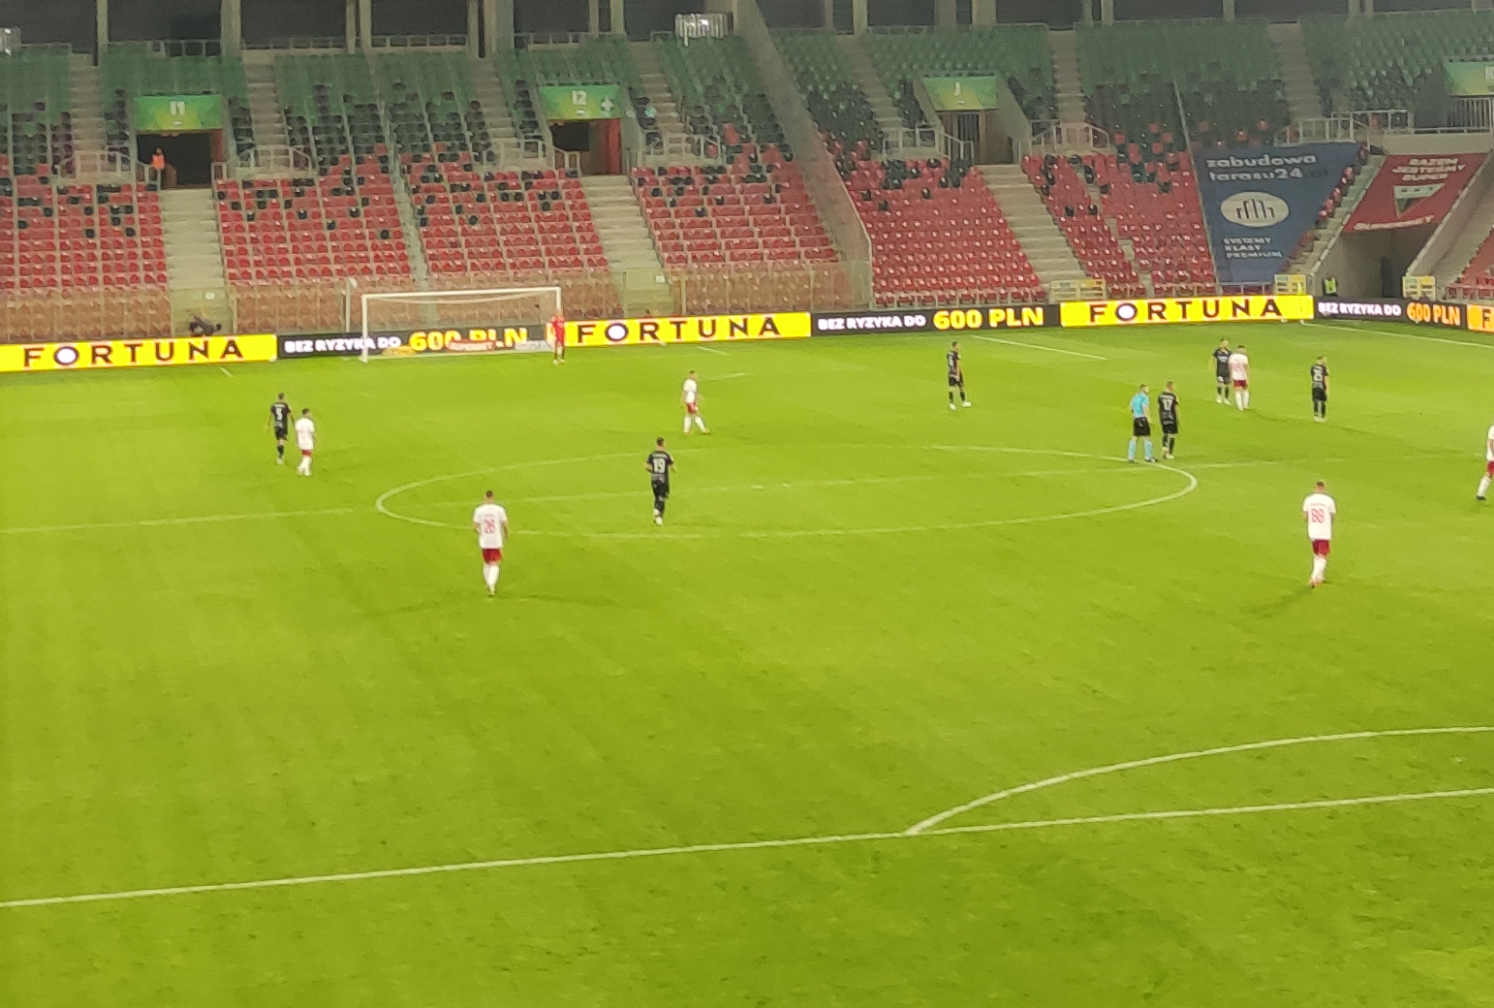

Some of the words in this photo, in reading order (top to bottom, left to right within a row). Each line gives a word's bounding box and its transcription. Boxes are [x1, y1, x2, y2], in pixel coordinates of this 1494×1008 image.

[1206, 154, 1317, 169] zabudowa
[817, 317, 845, 330] BEZ
[846, 315, 902, 330] RYZYKA
[904, 314, 927, 327] DO
[933, 309, 983, 330] 600
[988, 307, 1045, 327] PLN
[1089, 299, 1283, 323] FORTUNA
[1318, 301, 1338, 314] BEZ
[1339, 302, 1383, 316] RYZYKA
[1384, 303, 1402, 316] DO
[1407, 301, 1431, 323] 600
[1433, 305, 1461, 326] PLN
[577, 317, 781, 343] FORTUNA
[23, 339, 244, 368] FORTUNA
[284, 340, 314, 353] BEZ
[377, 336, 401, 349] DO
